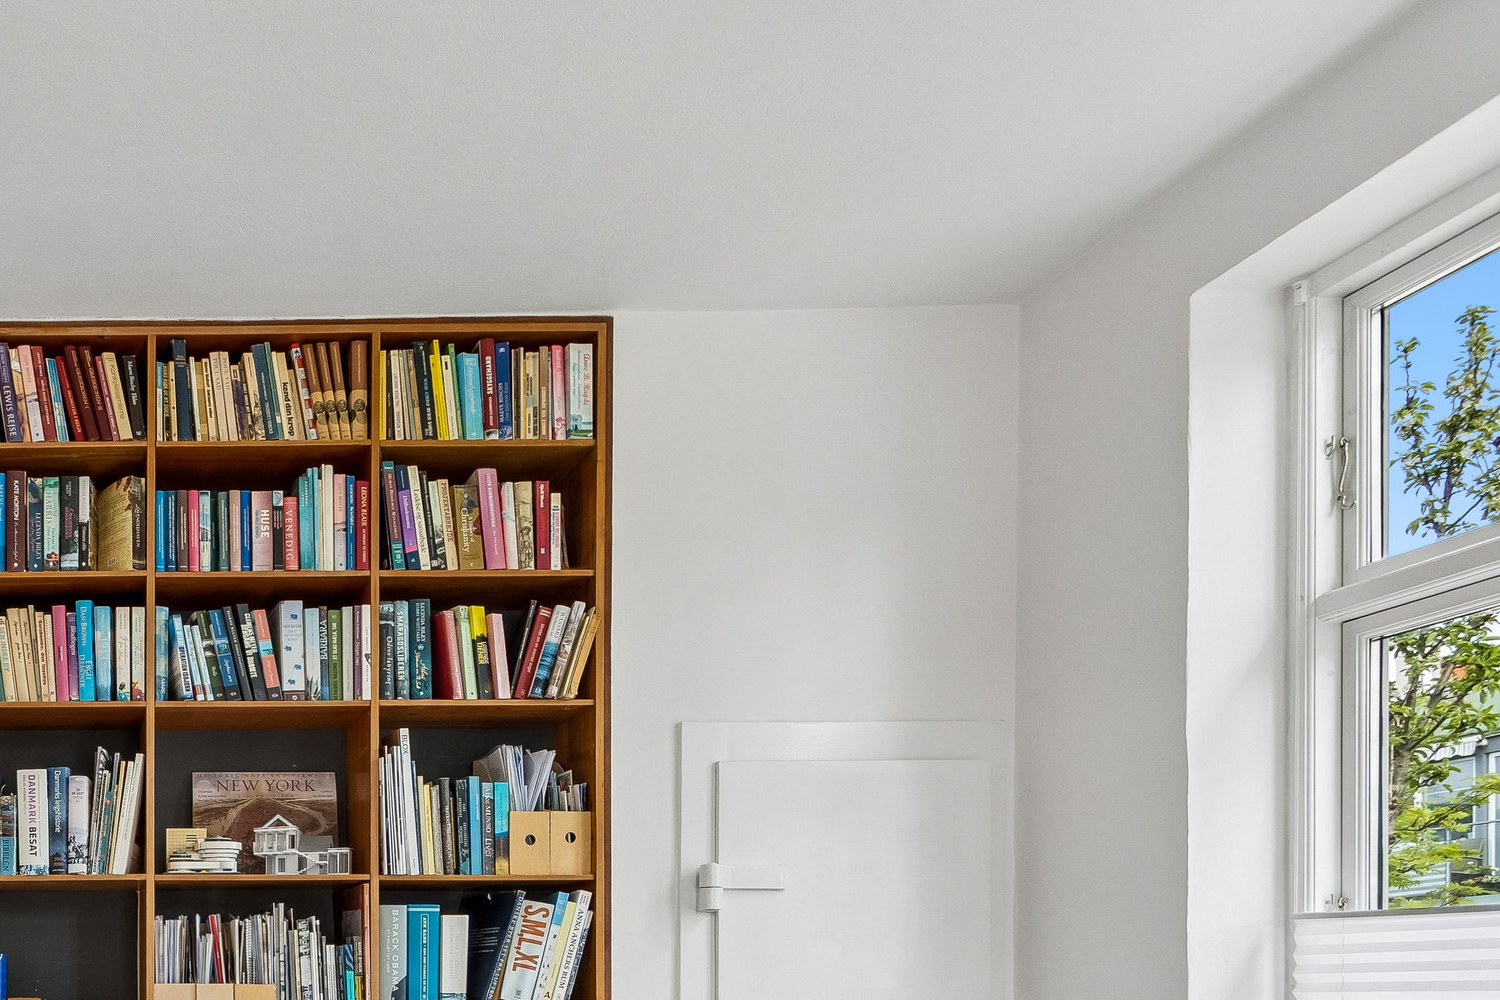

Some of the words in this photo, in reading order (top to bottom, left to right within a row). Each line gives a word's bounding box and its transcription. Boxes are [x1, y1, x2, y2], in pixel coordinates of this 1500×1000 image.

[485, 356, 493, 394] SKYGGEMAND
[3, 386, 13, 411] LEWIS
[282, 382, 291, 402] kend
[287, 417, 295, 436] krop
[7, 414, 17, 436] REJSE
[260, 510, 269, 538] HUSE
[442, 482, 453, 543] PROJEKTARBEJDE
[285, 510, 293, 560] VENEDIG
[417, 518, 427, 553] samarbejde
[461, 508, 471, 552] Christianity
[179, 647, 188, 671] OPERATION
[397, 610, 405, 681] SMARAGDSLIBEREN
[5, 663, 10, 672] BY
[384, 657, 393, 685] labyrint
[182, 672, 190, 693] ISBJØRN
[28, 775, 37, 824] DANMARK
[216, 780, 259, 792] NEW
[264, 780, 316, 792] YORK
[53, 800, 61, 833] krigshistorie
[2, 839, 10, 872] BIBELEN
[29, 827, 37, 856] BESAT
[512, 896, 523, 926] DANSKE
[574, 909, 584, 931] ANNA
[506, 926, 515, 943] BYER
[512, 905, 550, 972] S,M,L,XL
[563, 933, 578, 970] ANCHERS
[488, 974, 500, 999] LUFTEN
[558, 971, 567, 989] RUM
